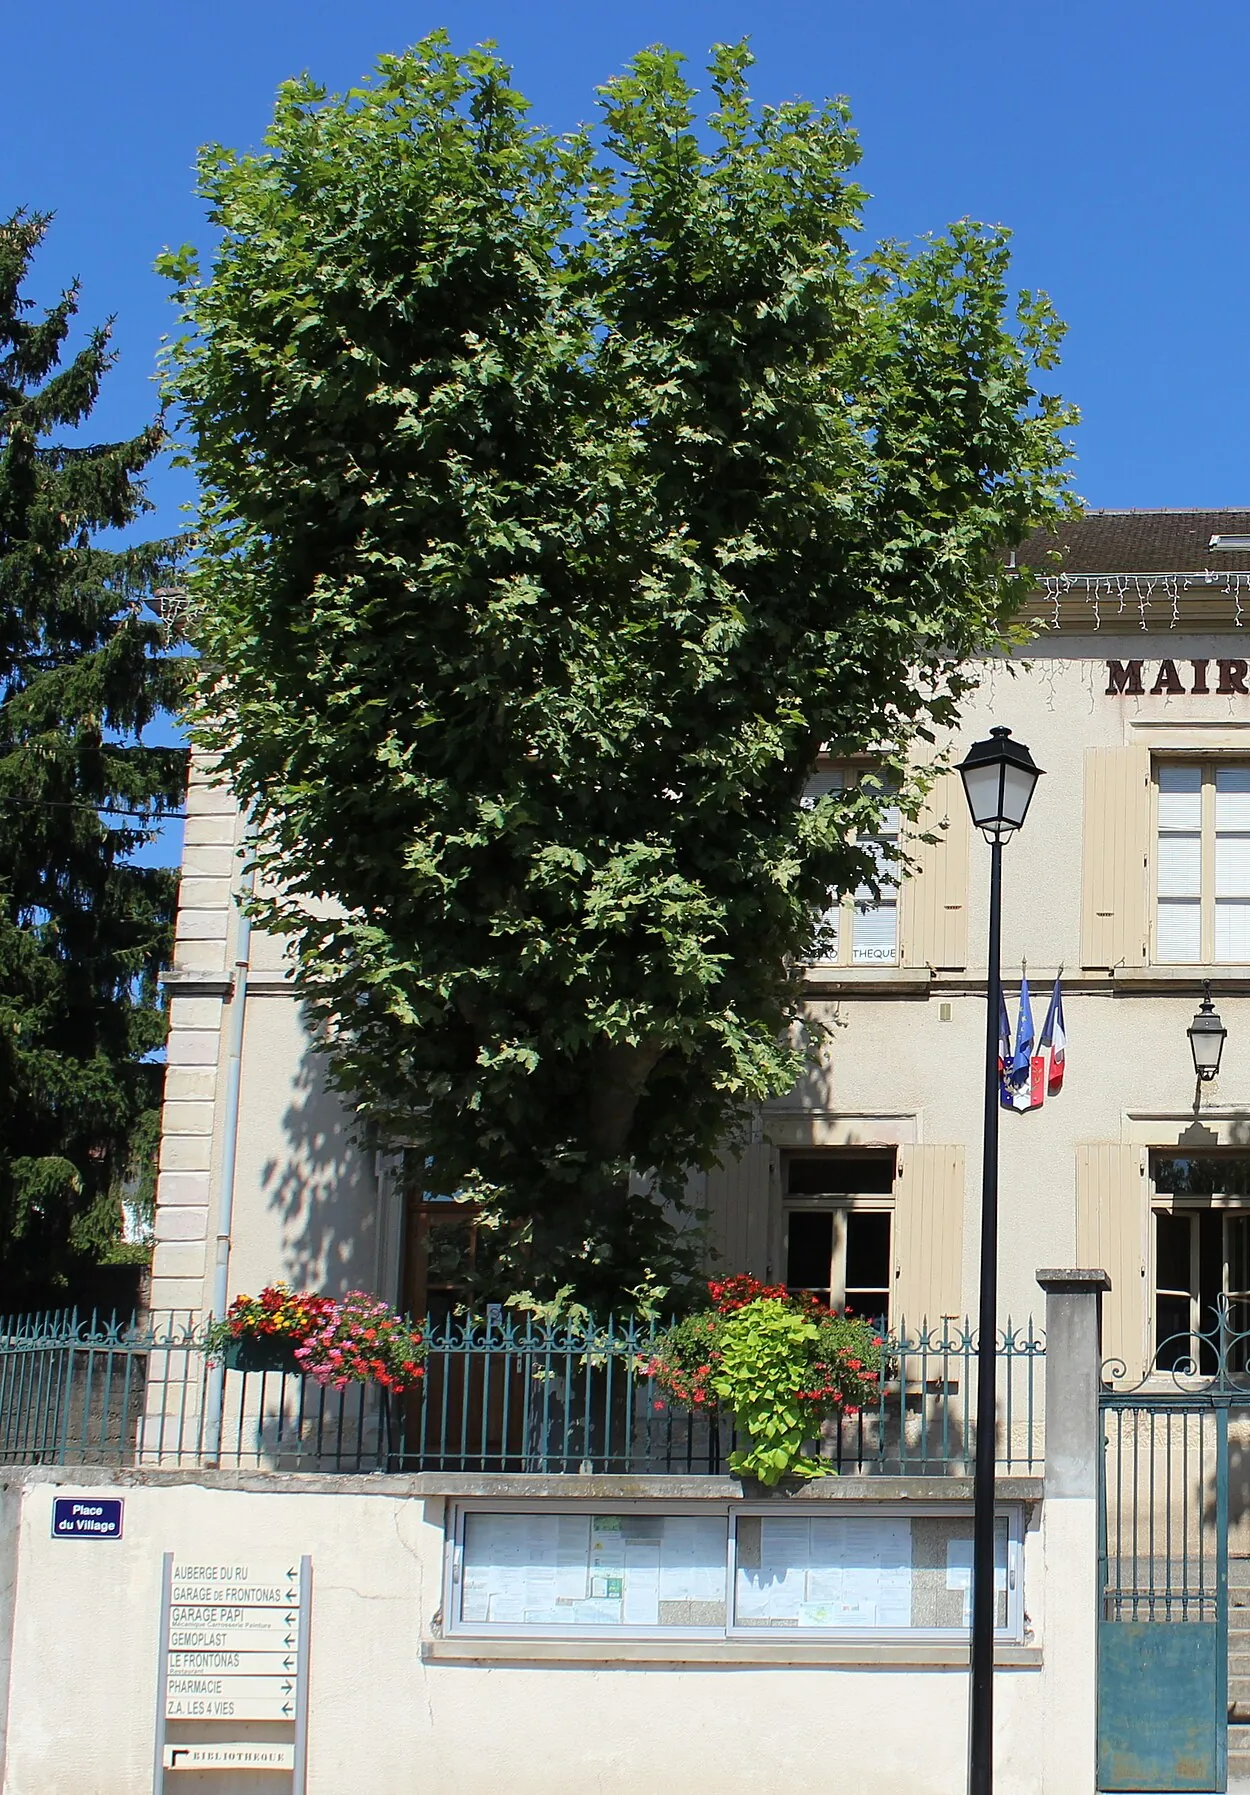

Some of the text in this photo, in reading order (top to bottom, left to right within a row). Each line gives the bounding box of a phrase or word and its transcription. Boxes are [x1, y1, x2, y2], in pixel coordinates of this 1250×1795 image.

[72, 1504, 103, 1516] Place
[59, 1519, 116, 1533] du Village
[174, 1567, 248, 1580] AUBERGE DU RU
[173, 1587, 212, 1601] GARAGE
[225, 1588, 281, 1602] FRONTONAS
[172, 1608, 244, 1621] GARAGE PAPI
[171, 1632, 227, 1647] GEMOPLAST
[170, 1653, 240, 1668] LE FRONTONAS
[168, 1680, 222, 1693] PHARMACIE
[168, 1701, 235, 1715] Z.A. LES 4 VIES
